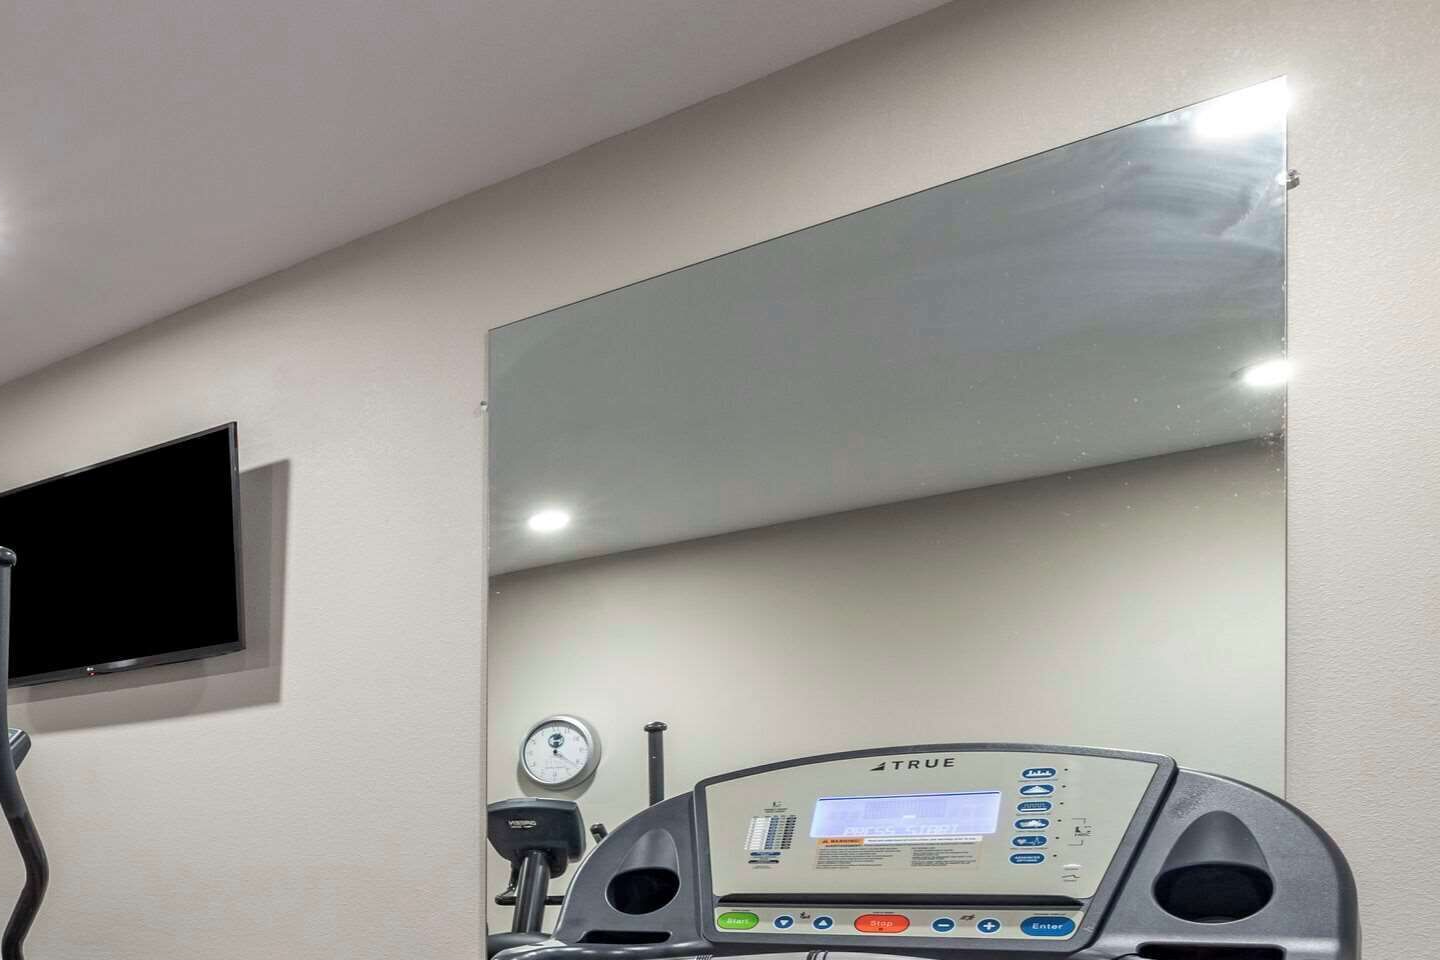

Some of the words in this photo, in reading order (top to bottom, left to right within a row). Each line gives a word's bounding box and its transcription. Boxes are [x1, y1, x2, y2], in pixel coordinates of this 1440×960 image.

[891, 757, 955, 770] TRUE
[726, 917, 750, 925] Start
[870, 920, 894, 928] Stop
[1031, 922, 1064, 930] Enter
